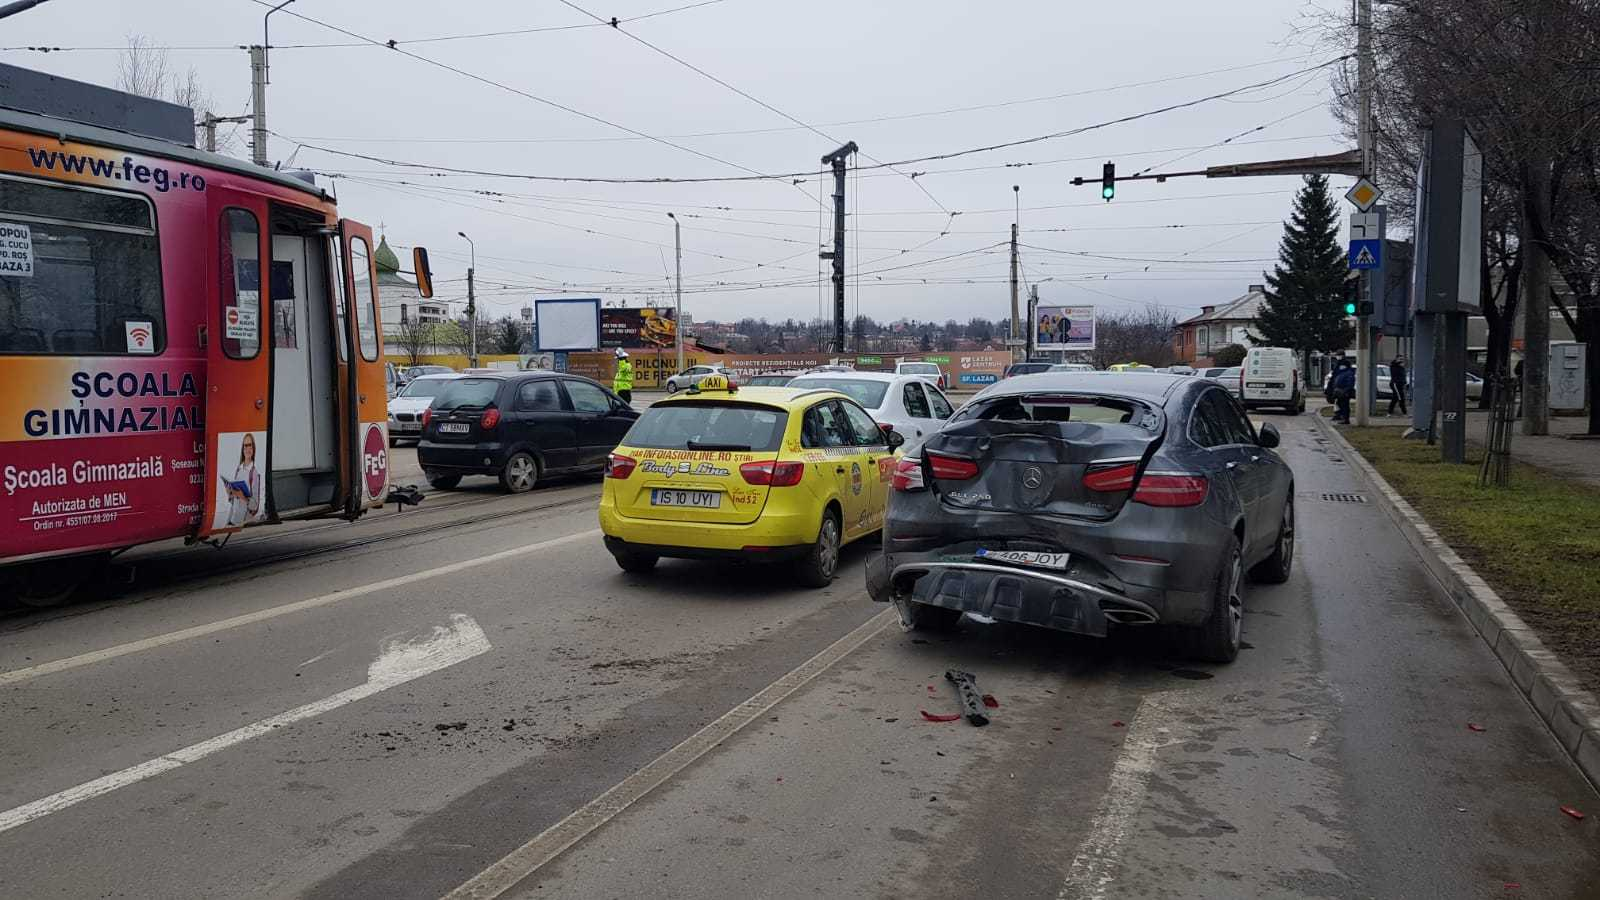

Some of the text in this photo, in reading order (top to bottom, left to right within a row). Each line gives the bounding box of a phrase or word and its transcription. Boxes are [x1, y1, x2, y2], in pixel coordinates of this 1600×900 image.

[28, 148, 206, 192] www.feg.ro
[8, 241, 29, 250] CUCU
[25, 263, 31, 272] 3
[635, 371, 649, 380] DE
[704, 376, 721, 388] TAXI
[71, 371, 197, 407] ȘCOALA
[24, 406, 205, 437] GIMNAZIAL
[72, 455, 164, 484] Gimnazială
[32, 491, 127, 516] Autorizata de MEN
[660, 491, 713, 506] IS 10 UYI
[33, 517, 54, 531] Ordin
[1035, 553, 1063, 566] JOY
